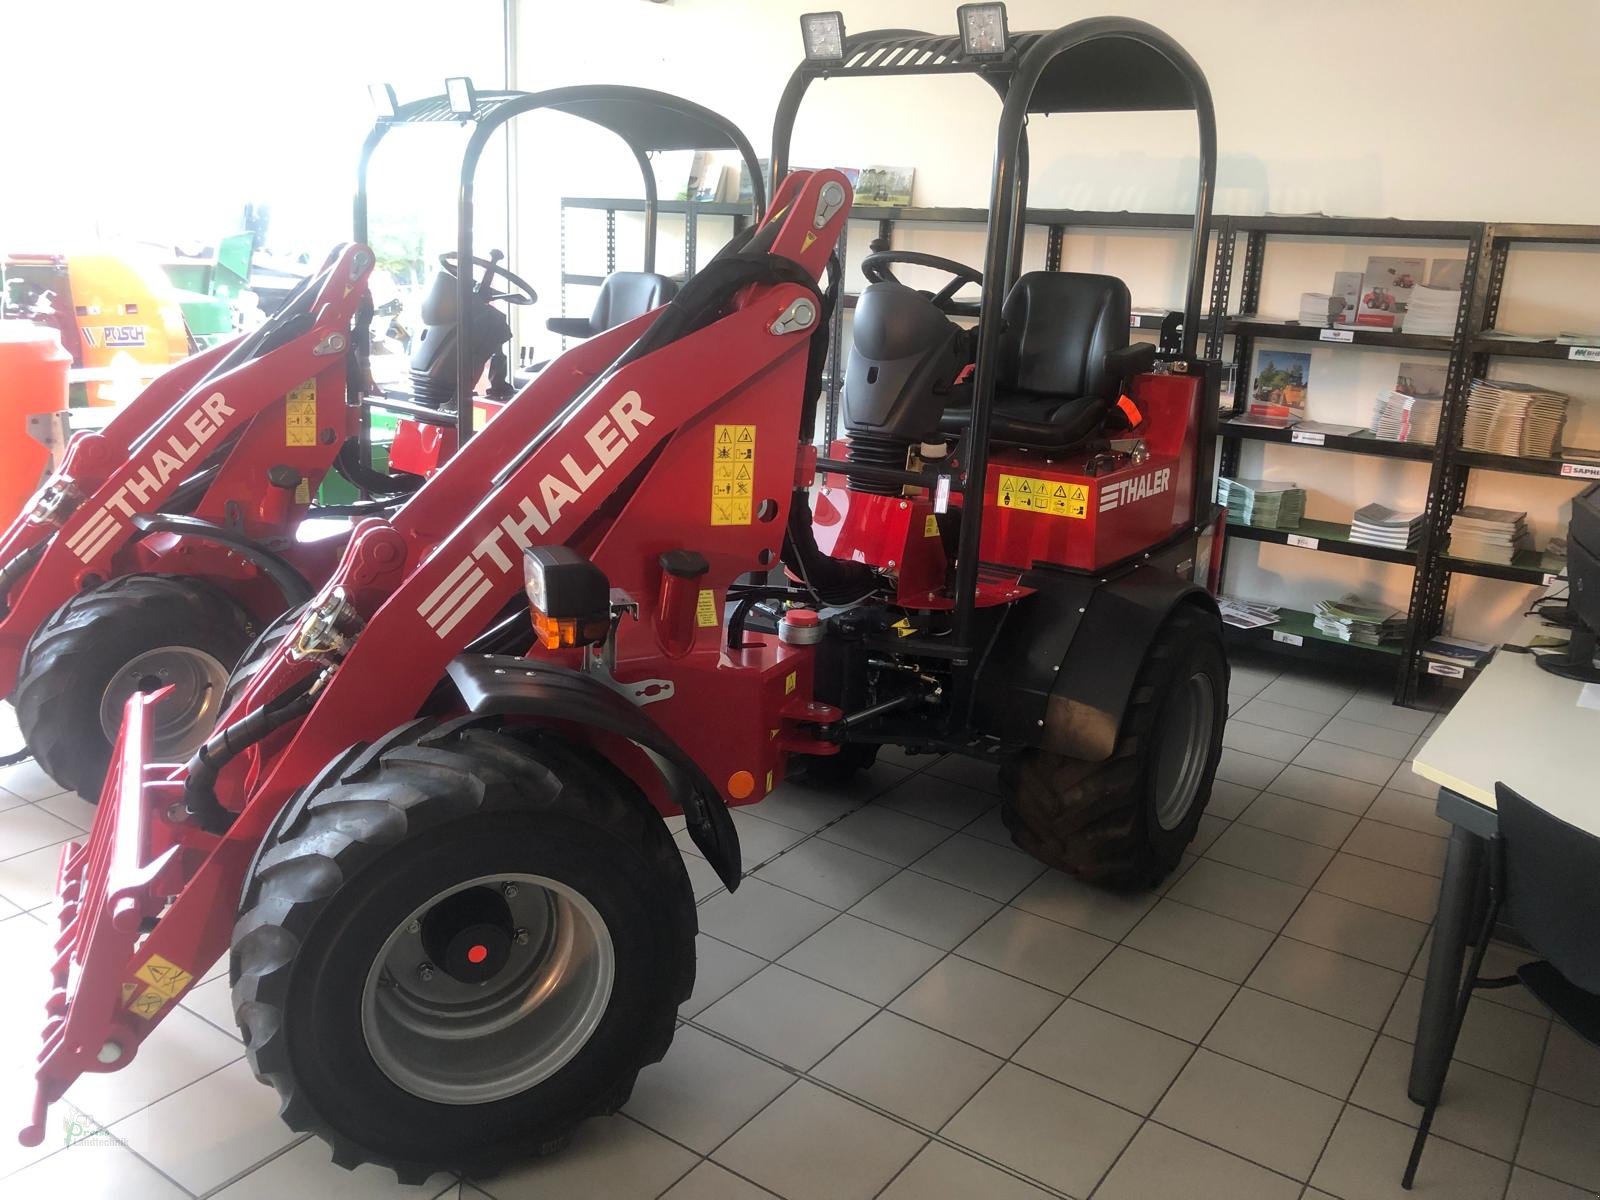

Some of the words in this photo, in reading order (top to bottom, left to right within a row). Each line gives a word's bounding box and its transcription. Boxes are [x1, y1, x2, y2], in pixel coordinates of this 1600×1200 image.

[106, 391, 236, 517] THALER
[472, 390, 656, 574] THALER
[1119, 468, 1170, 506] THALER
